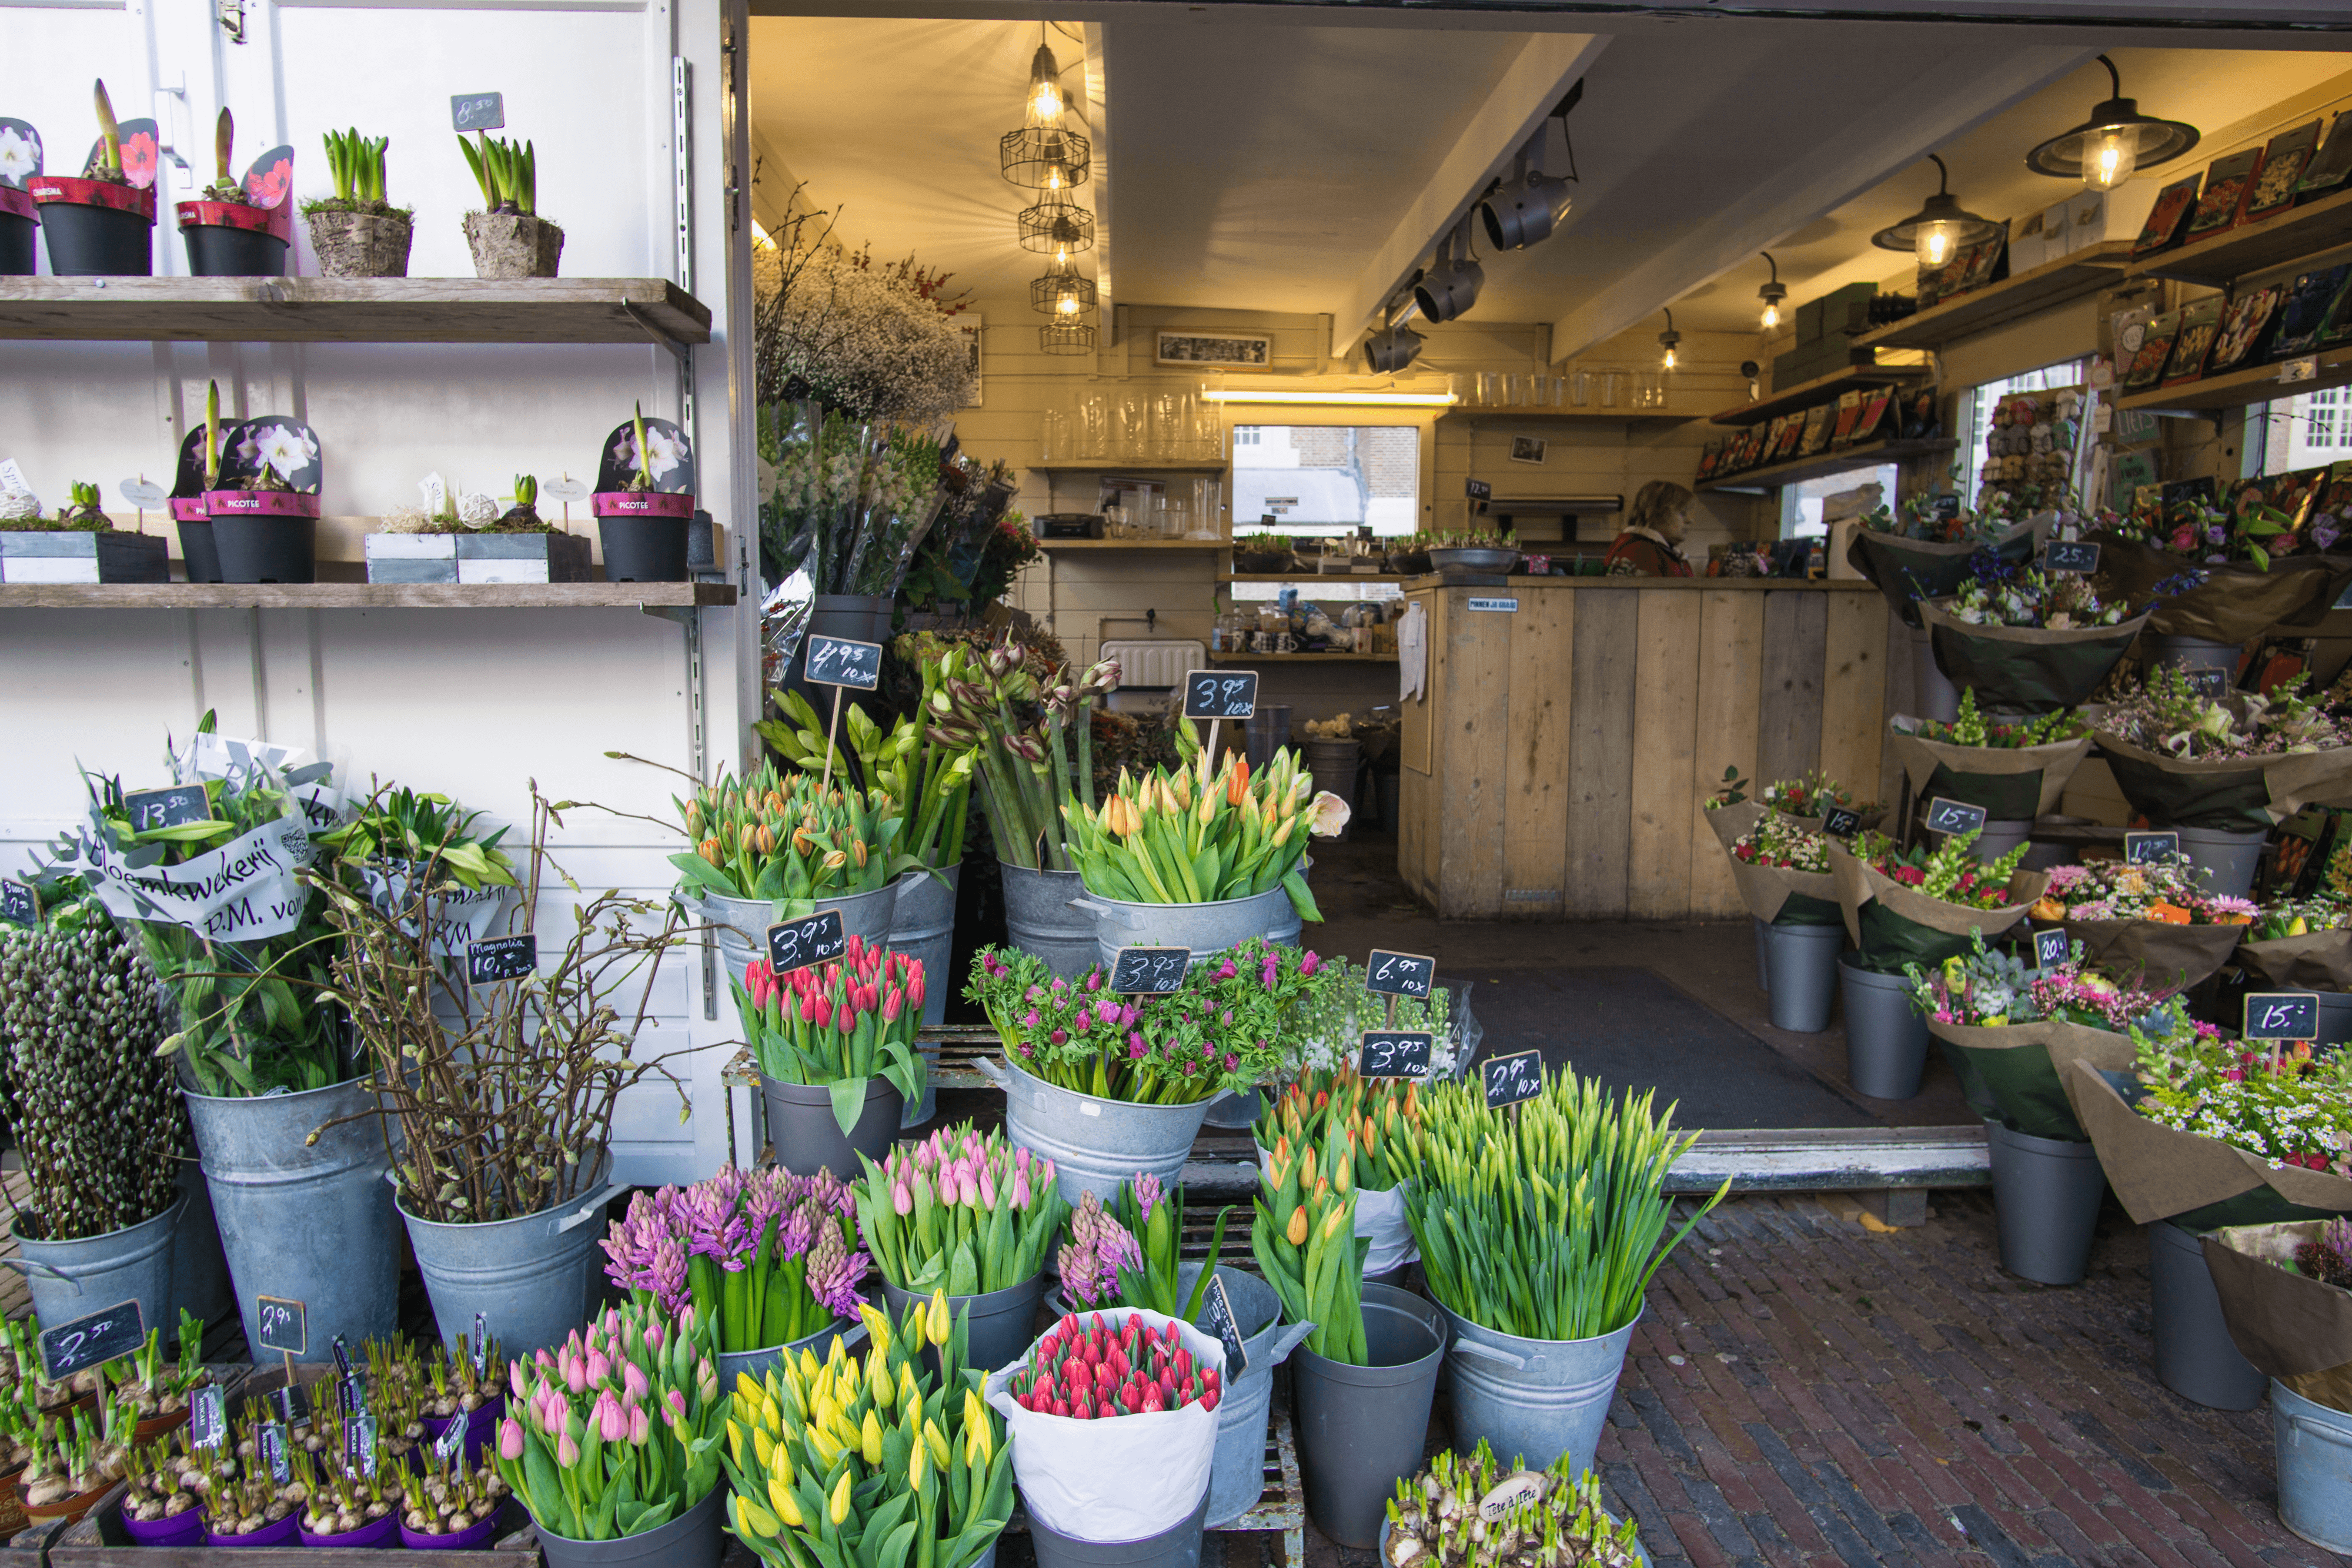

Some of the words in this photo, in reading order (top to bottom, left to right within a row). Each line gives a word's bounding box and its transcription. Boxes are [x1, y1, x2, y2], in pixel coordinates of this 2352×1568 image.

[228, 500, 259, 509] PICOTEE
[619, 502, 649, 511] PICOTEE
[1196, 677, 1249, 708] 3.95
[470, 938, 524, 955] Magnolia
[774, 917, 828, 966] 3.95
[516, 963, 532, 974] bos
[1376, 957, 1419, 981] 6.95
[1371, 1041, 1427, 1069] 3.95
